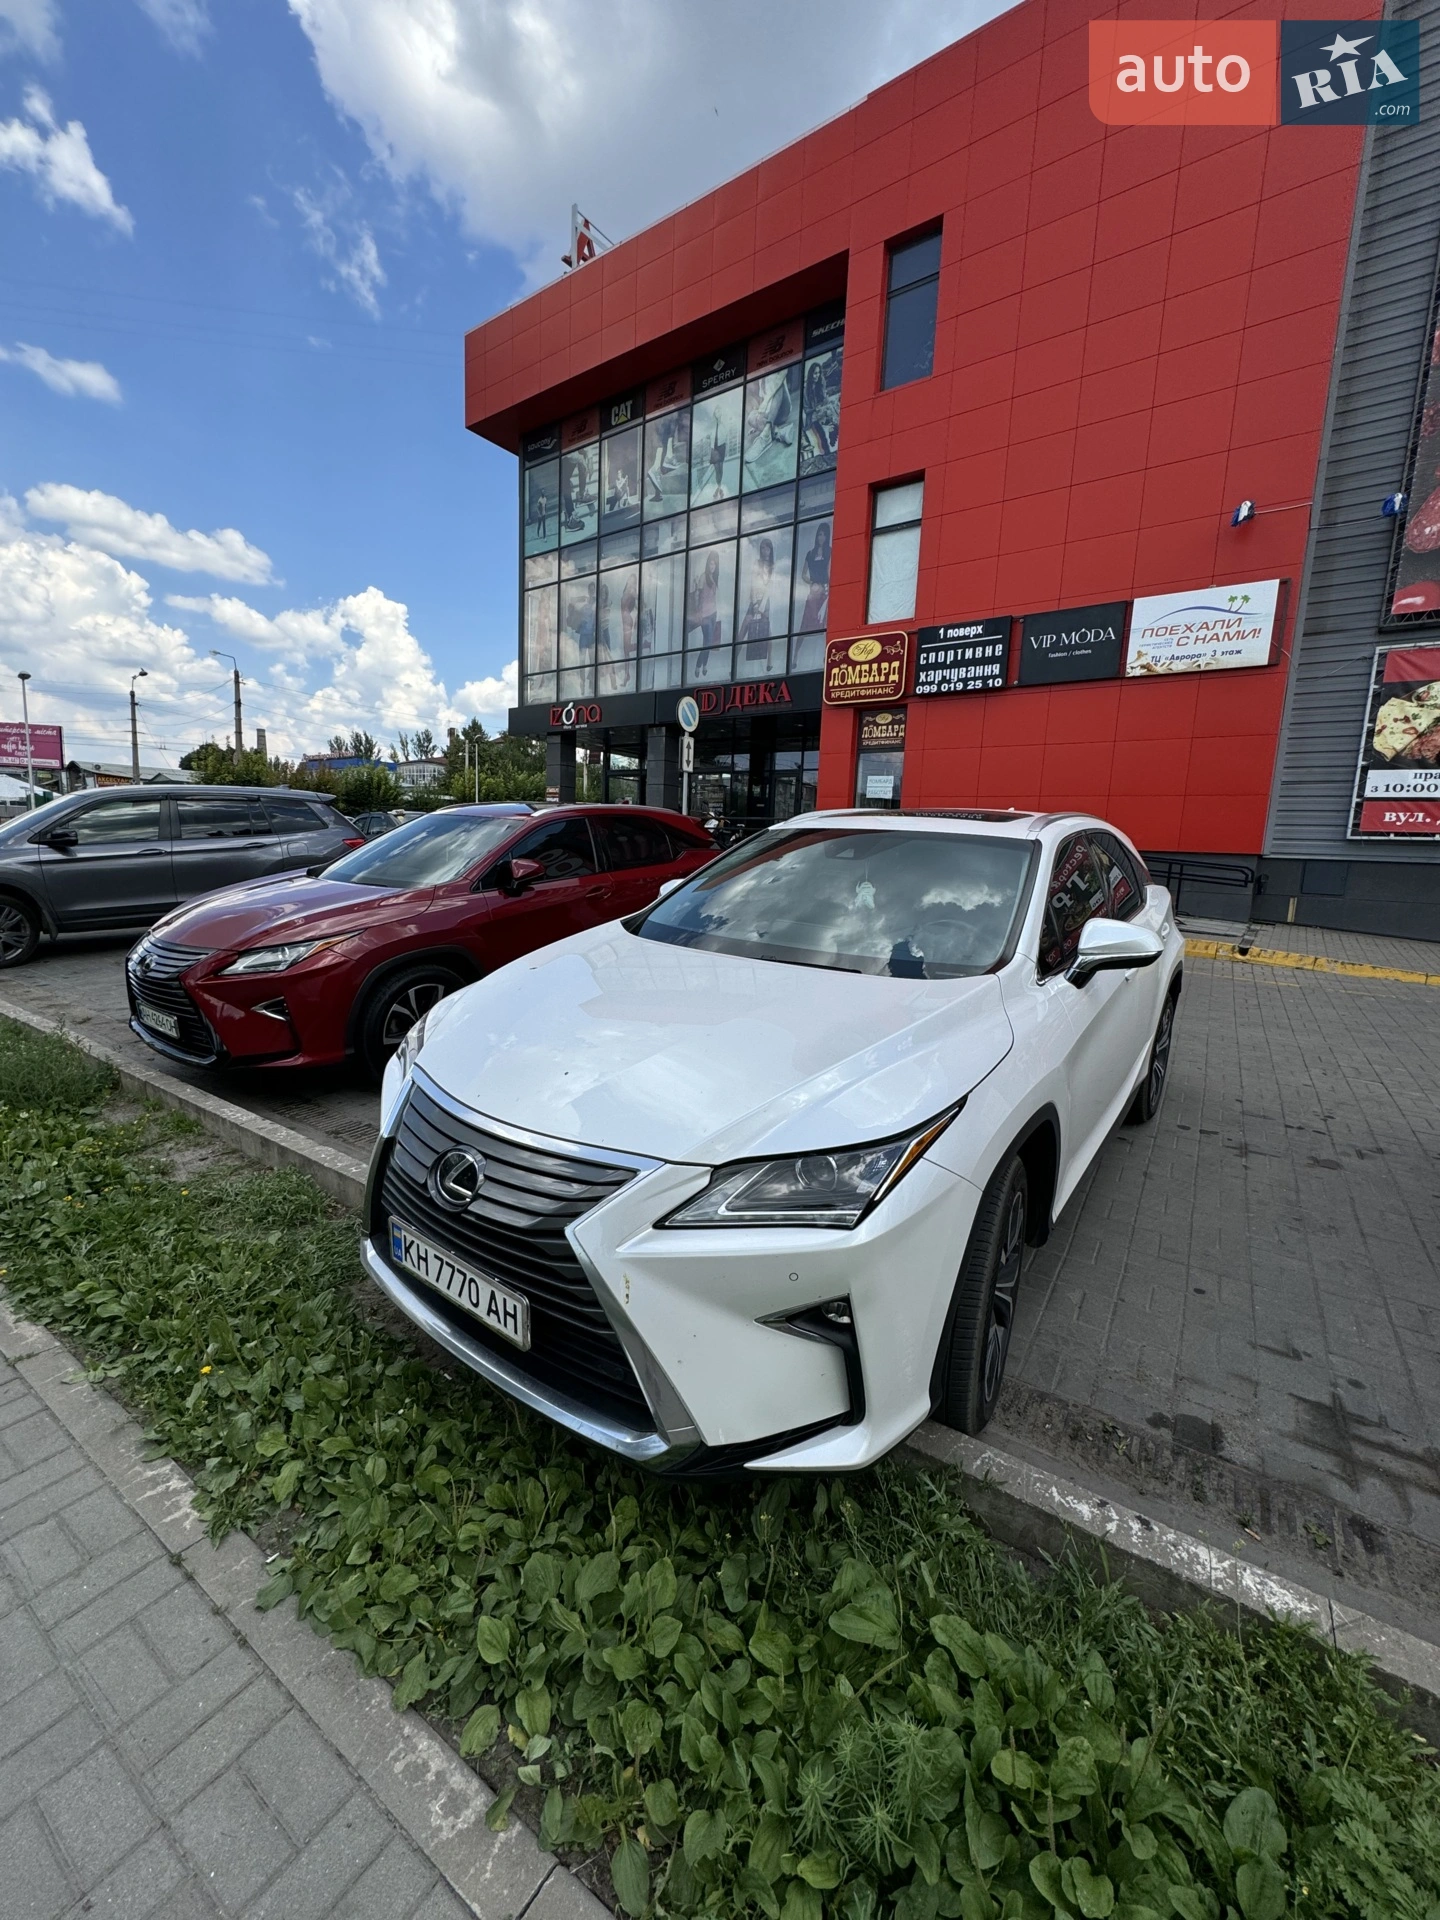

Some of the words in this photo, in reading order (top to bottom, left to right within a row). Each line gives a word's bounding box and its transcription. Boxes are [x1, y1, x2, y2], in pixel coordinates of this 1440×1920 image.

[702, 367, 737, 388] SPERRY
[611, 400, 633, 426] CAT
[939, 627, 944, 639] 1
[947, 624, 984, 638] поверх
[1141, 617, 1243, 639] ПОЕХАЛИ
[1176, 636, 1190, 647] С
[1193, 627, 1262, 646] НАМИ!
[1030, 634, 1056, 650] VIP
[919, 644, 1003, 665] спортивне
[1151, 655, 1162, 663] ТЦ
[1164, 651, 1207, 662] «Аврора»
[1211, 649, 1217, 658] 3
[1220, 648, 1243, 657] этаж
[829, 661, 900, 687] ЛОМБАРД
[918, 663, 1001, 684] харчування
[725, 681, 791, 712] ДЕКА
[831, 686, 895, 699] КРЕДИТФИНАНС
[915, 684, 938, 695] 099
[941, 682, 963, 692] 019
[966, 679, 982, 689] 25
[986, 678, 1003, 688] 10
[861, 724, 905, 739] ЛОМБАРД
[1383, 783, 1439, 793] 10:00
[1383, 811, 1431, 826] вул.
[403, 1233, 430, 1278] KH
[434, 1253, 480, 1310] 7770
[486, 1289, 519, 1336] AH
